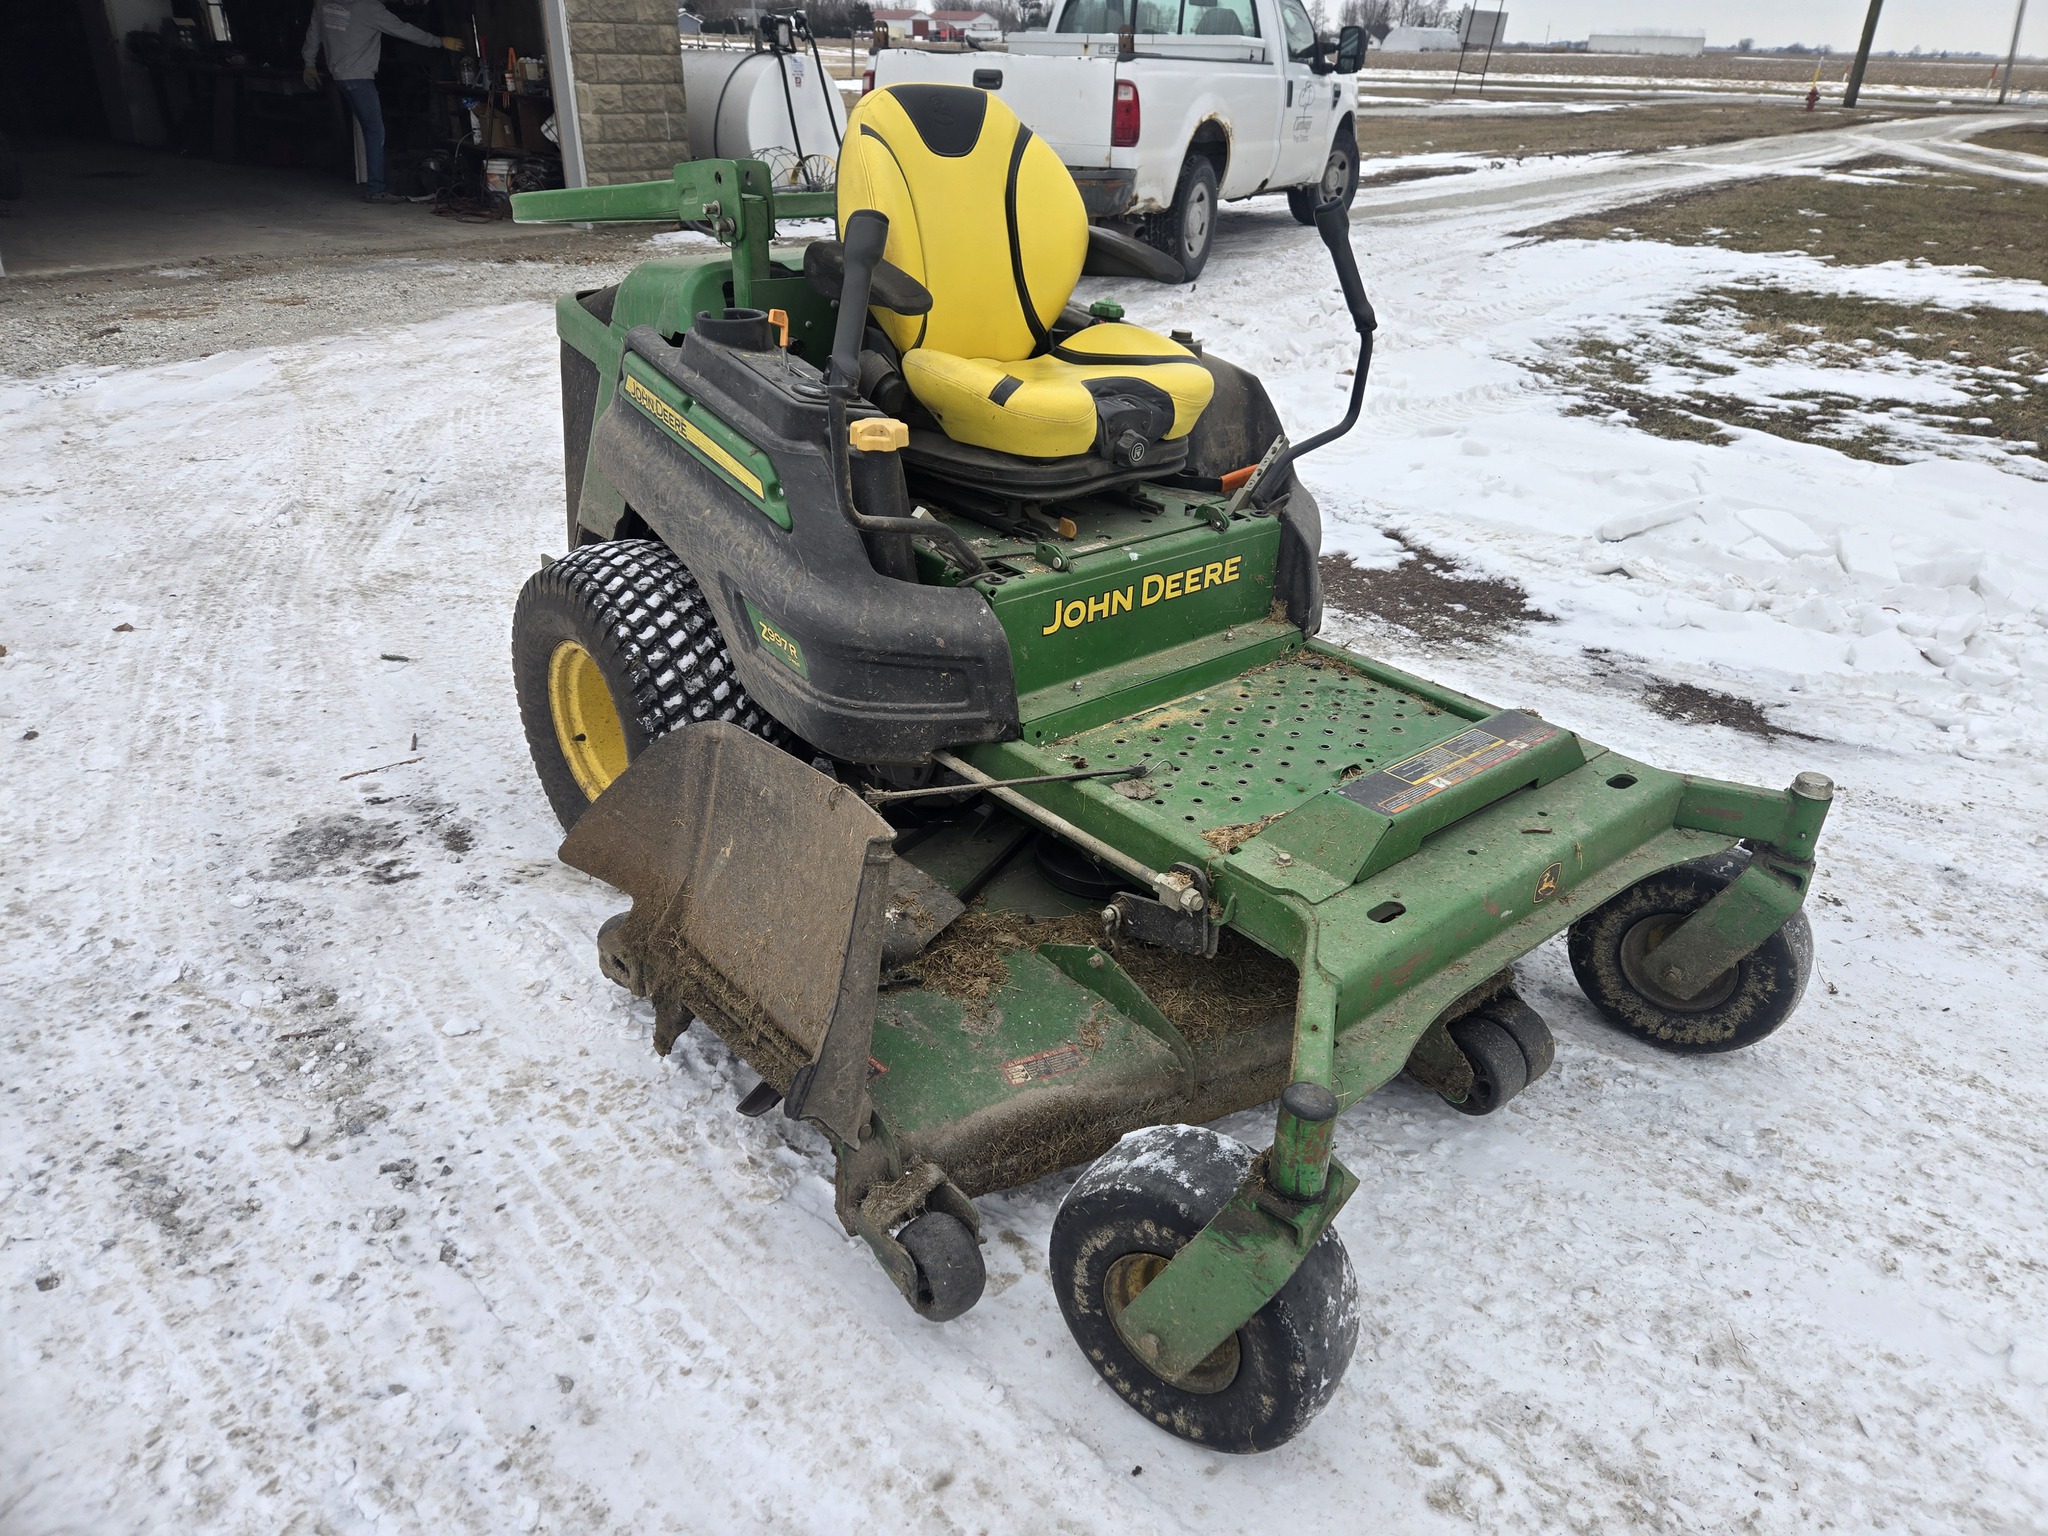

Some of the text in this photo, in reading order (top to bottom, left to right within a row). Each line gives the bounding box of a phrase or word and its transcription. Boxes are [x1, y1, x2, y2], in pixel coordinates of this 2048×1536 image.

[630, 381, 688, 439] JOHN DEERE
[1042, 555, 1242, 636] JOHN DEERE
[758, 620, 799, 660] Z997R
